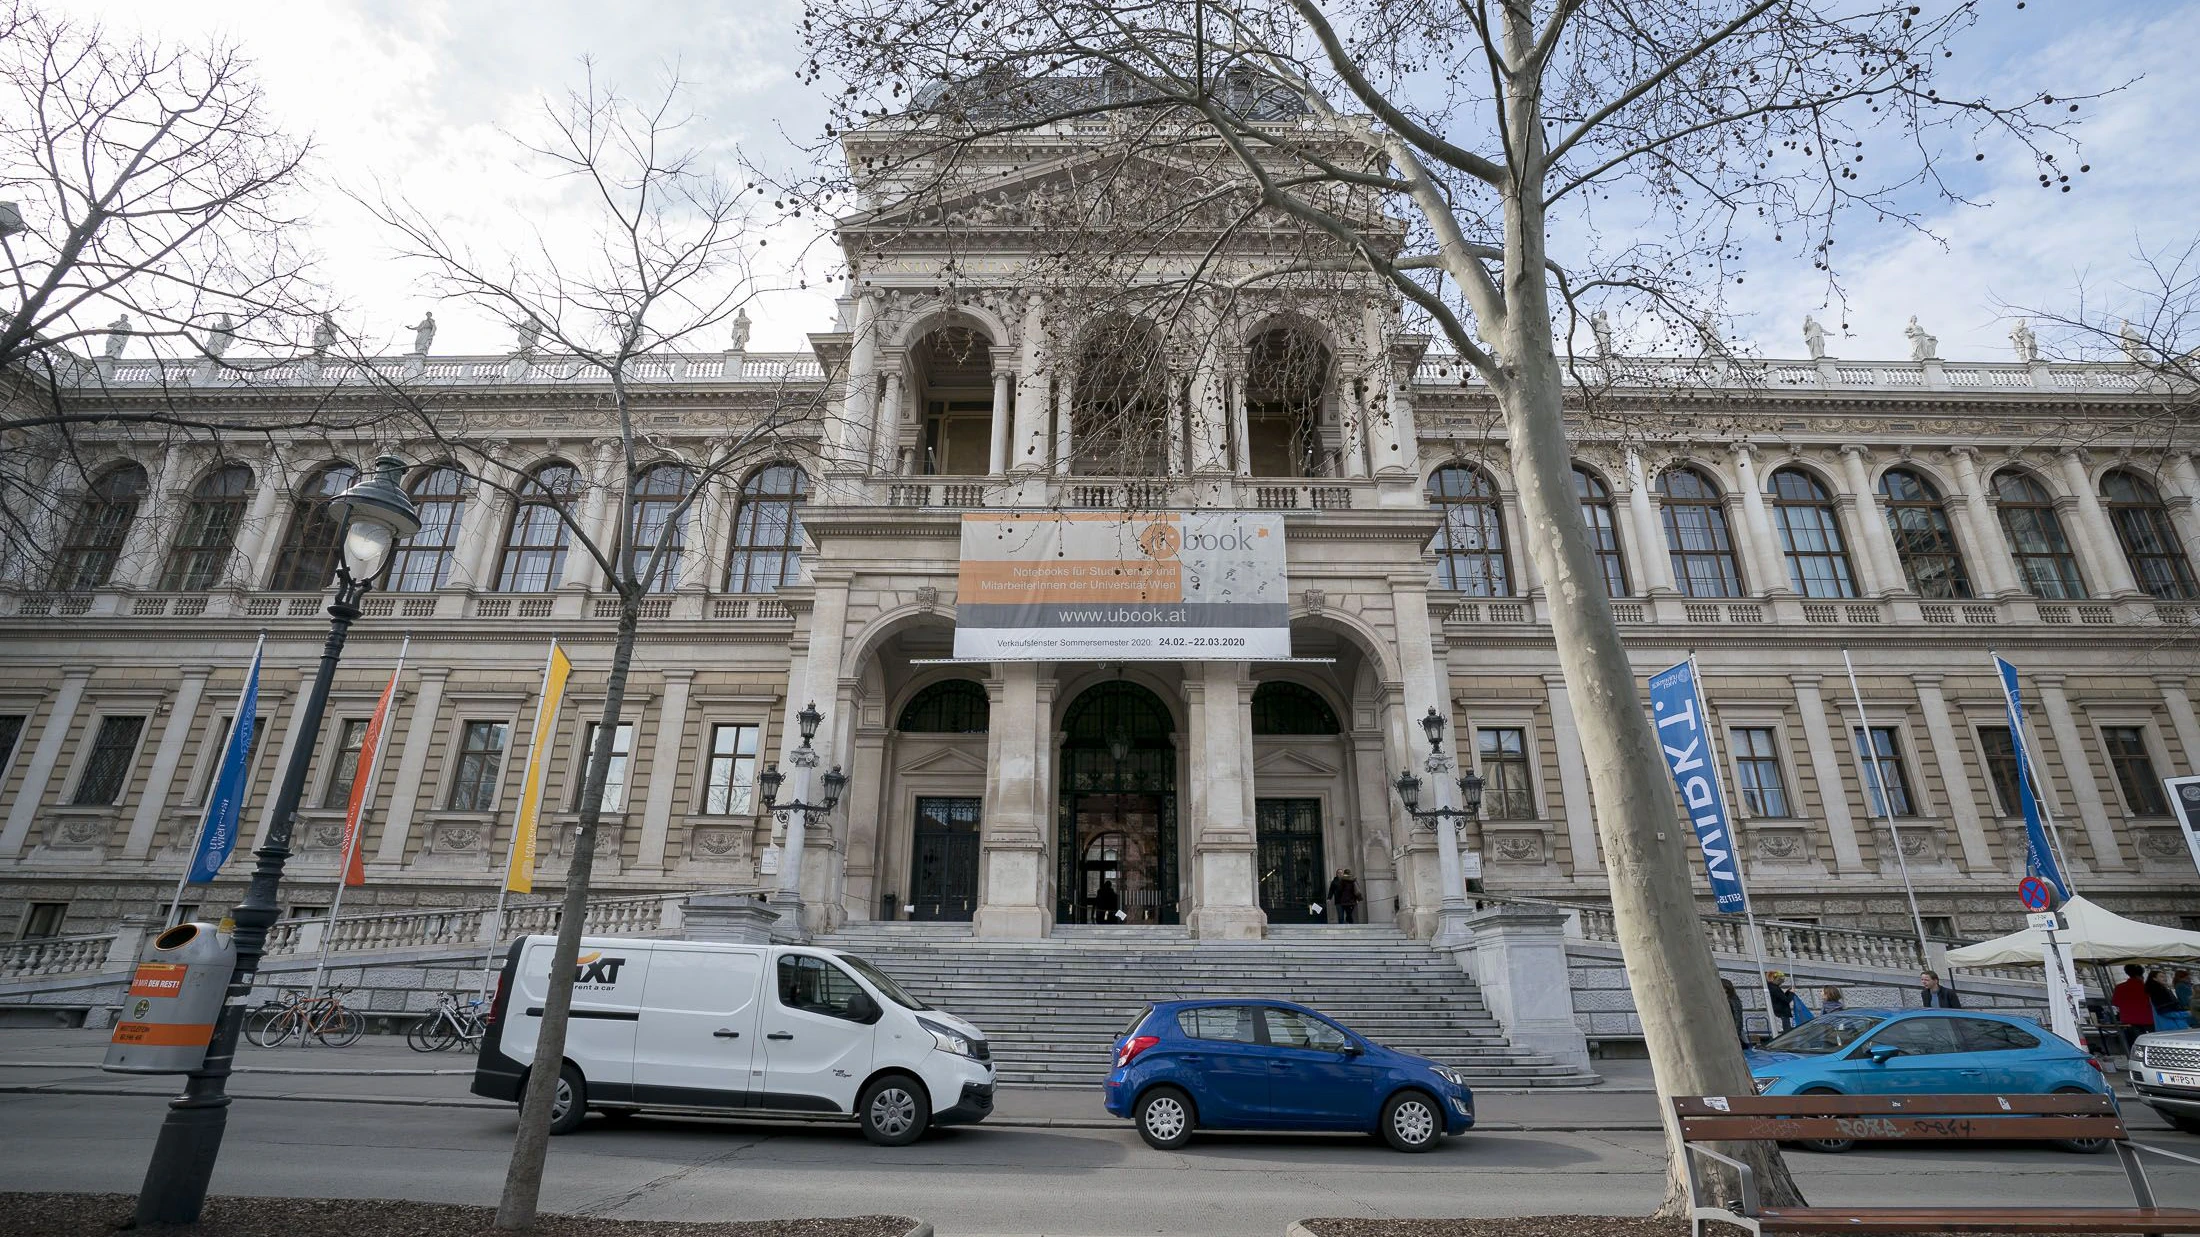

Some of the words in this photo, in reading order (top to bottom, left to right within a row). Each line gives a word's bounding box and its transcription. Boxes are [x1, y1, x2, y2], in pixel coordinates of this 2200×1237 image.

[1013, 567, 1069, 577] Notebooks
[1072, 566, 1085, 577] für
[1089, 565, 1152, 577] Studerende
[1156, 565, 1176, 576] und
[981, 580, 1066, 591] MitarbeiterInnen
[1070, 580, 1088, 590] der
[1090, 579, 1147, 590] Universität
[1150, 579, 1176, 590] Wien
[1058, 607, 1187, 622] www.ubook.at
[997, 639, 1057, 647] Verkaufsfenster
[1060, 638, 1129, 647] Sommersemester
[1131, 638, 1153, 647] 2020:
[548, 957, 626, 984] IXT
[148, 980, 159, 988] DEN
[159, 980, 180, 989] REST!
